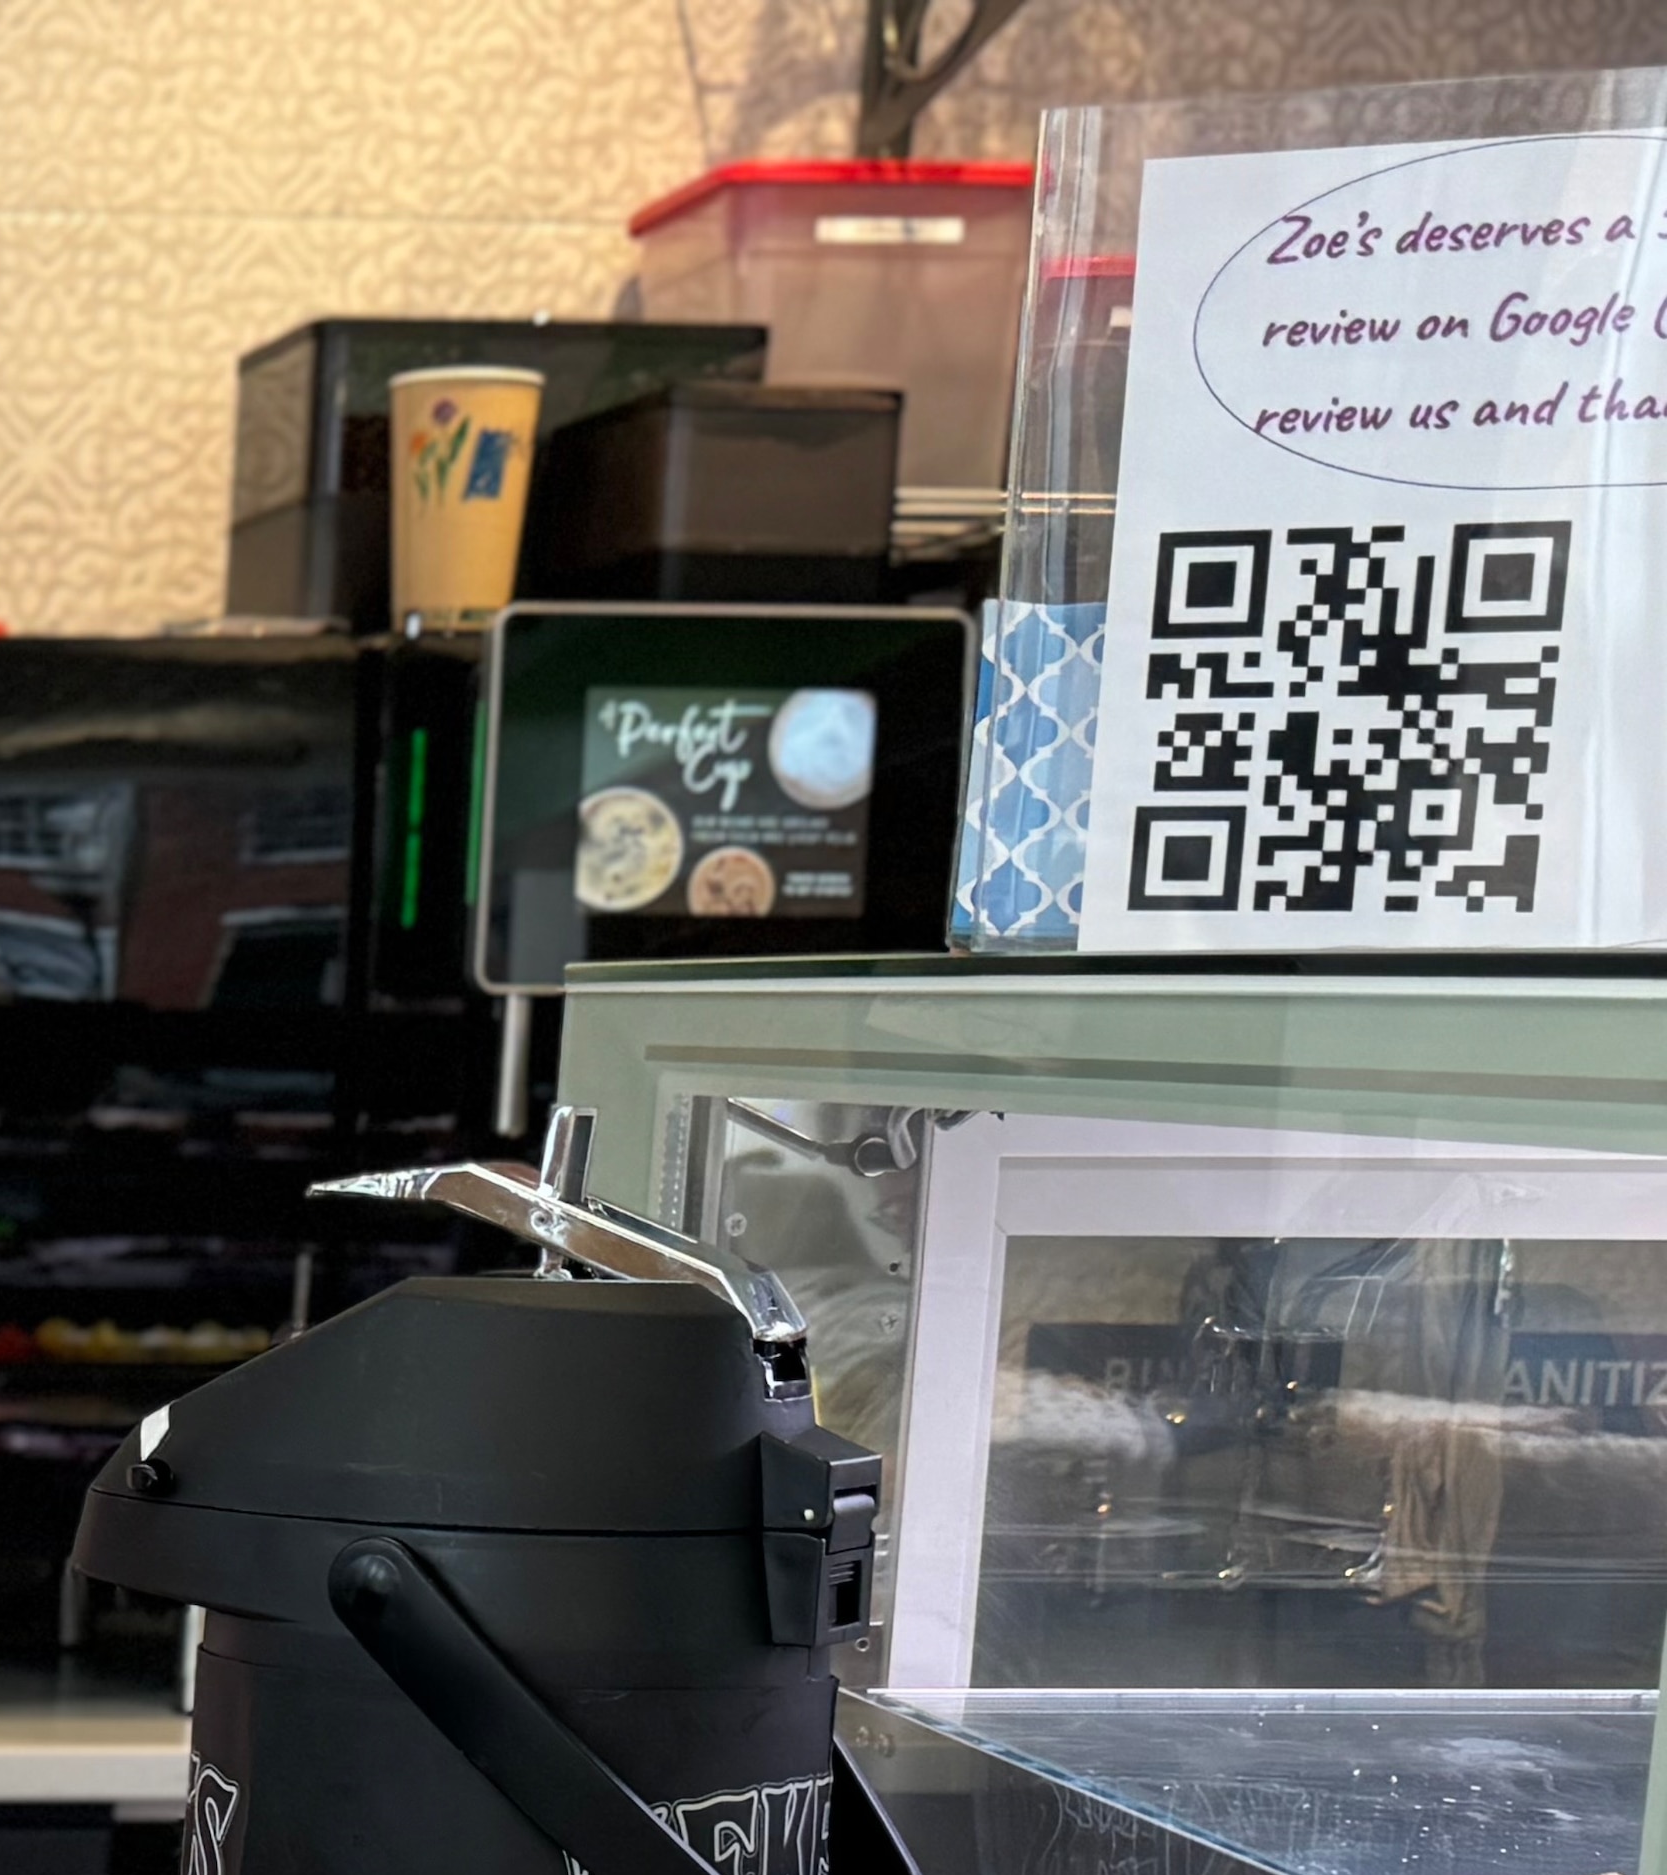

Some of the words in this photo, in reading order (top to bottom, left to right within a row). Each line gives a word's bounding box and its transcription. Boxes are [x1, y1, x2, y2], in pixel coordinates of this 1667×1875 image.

[1267, 211, 1383, 265] Zoe's
[1394, 211, 1591, 255] deserves
[1605, 215, 1636, 242] a
[1263, 309, 1401, 348] review
[1416, 312, 1469, 340] on
[1489, 292, 1636, 346] Google
[1254, 397, 1393, 434] review
[1410, 401, 1459, 430] us
[1473, 381, 1569, 428] and
[1577, 378, 1667, 424] tha
[617, 699, 773, 764] Perfect
[682, 745, 753, 812] Cup
